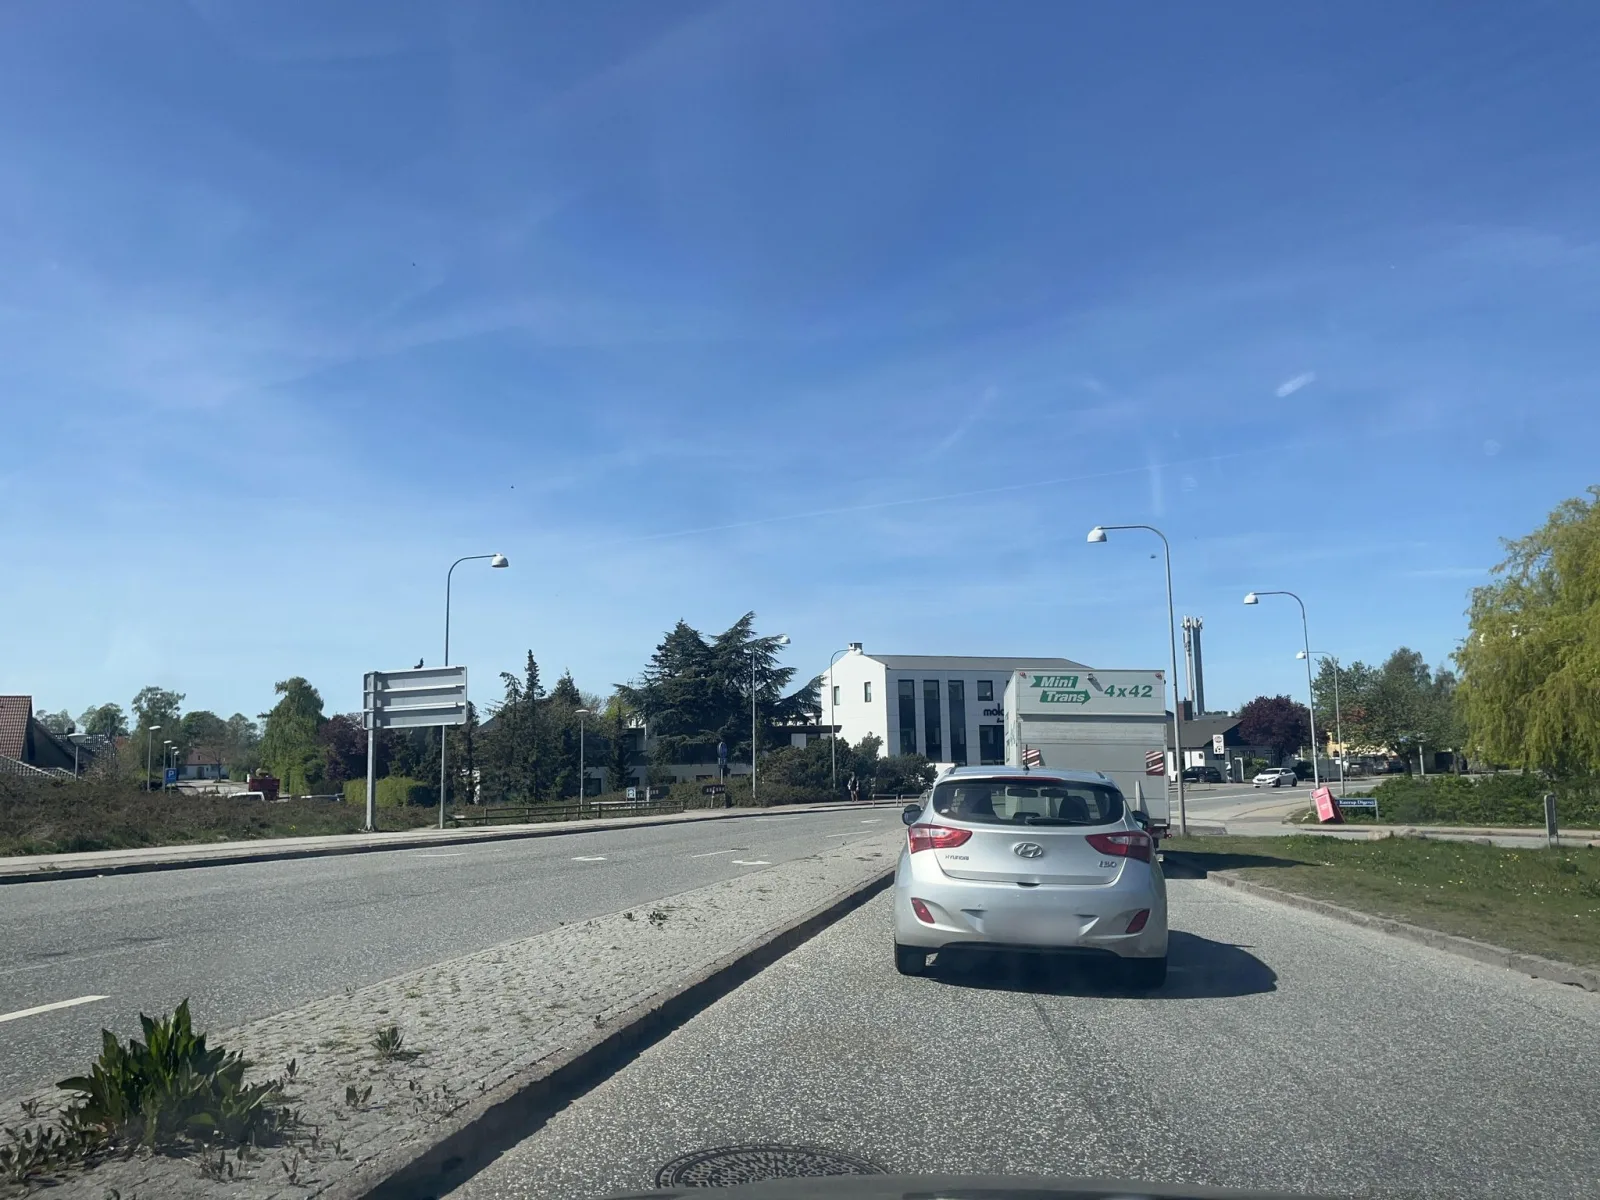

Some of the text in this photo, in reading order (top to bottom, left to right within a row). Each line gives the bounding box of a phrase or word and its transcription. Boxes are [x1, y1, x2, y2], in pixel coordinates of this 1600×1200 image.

[1040, 676, 1075, 688] Mini
[1046, 691, 1085, 702] Trans
[1104, 685, 1153, 698] 4x42
